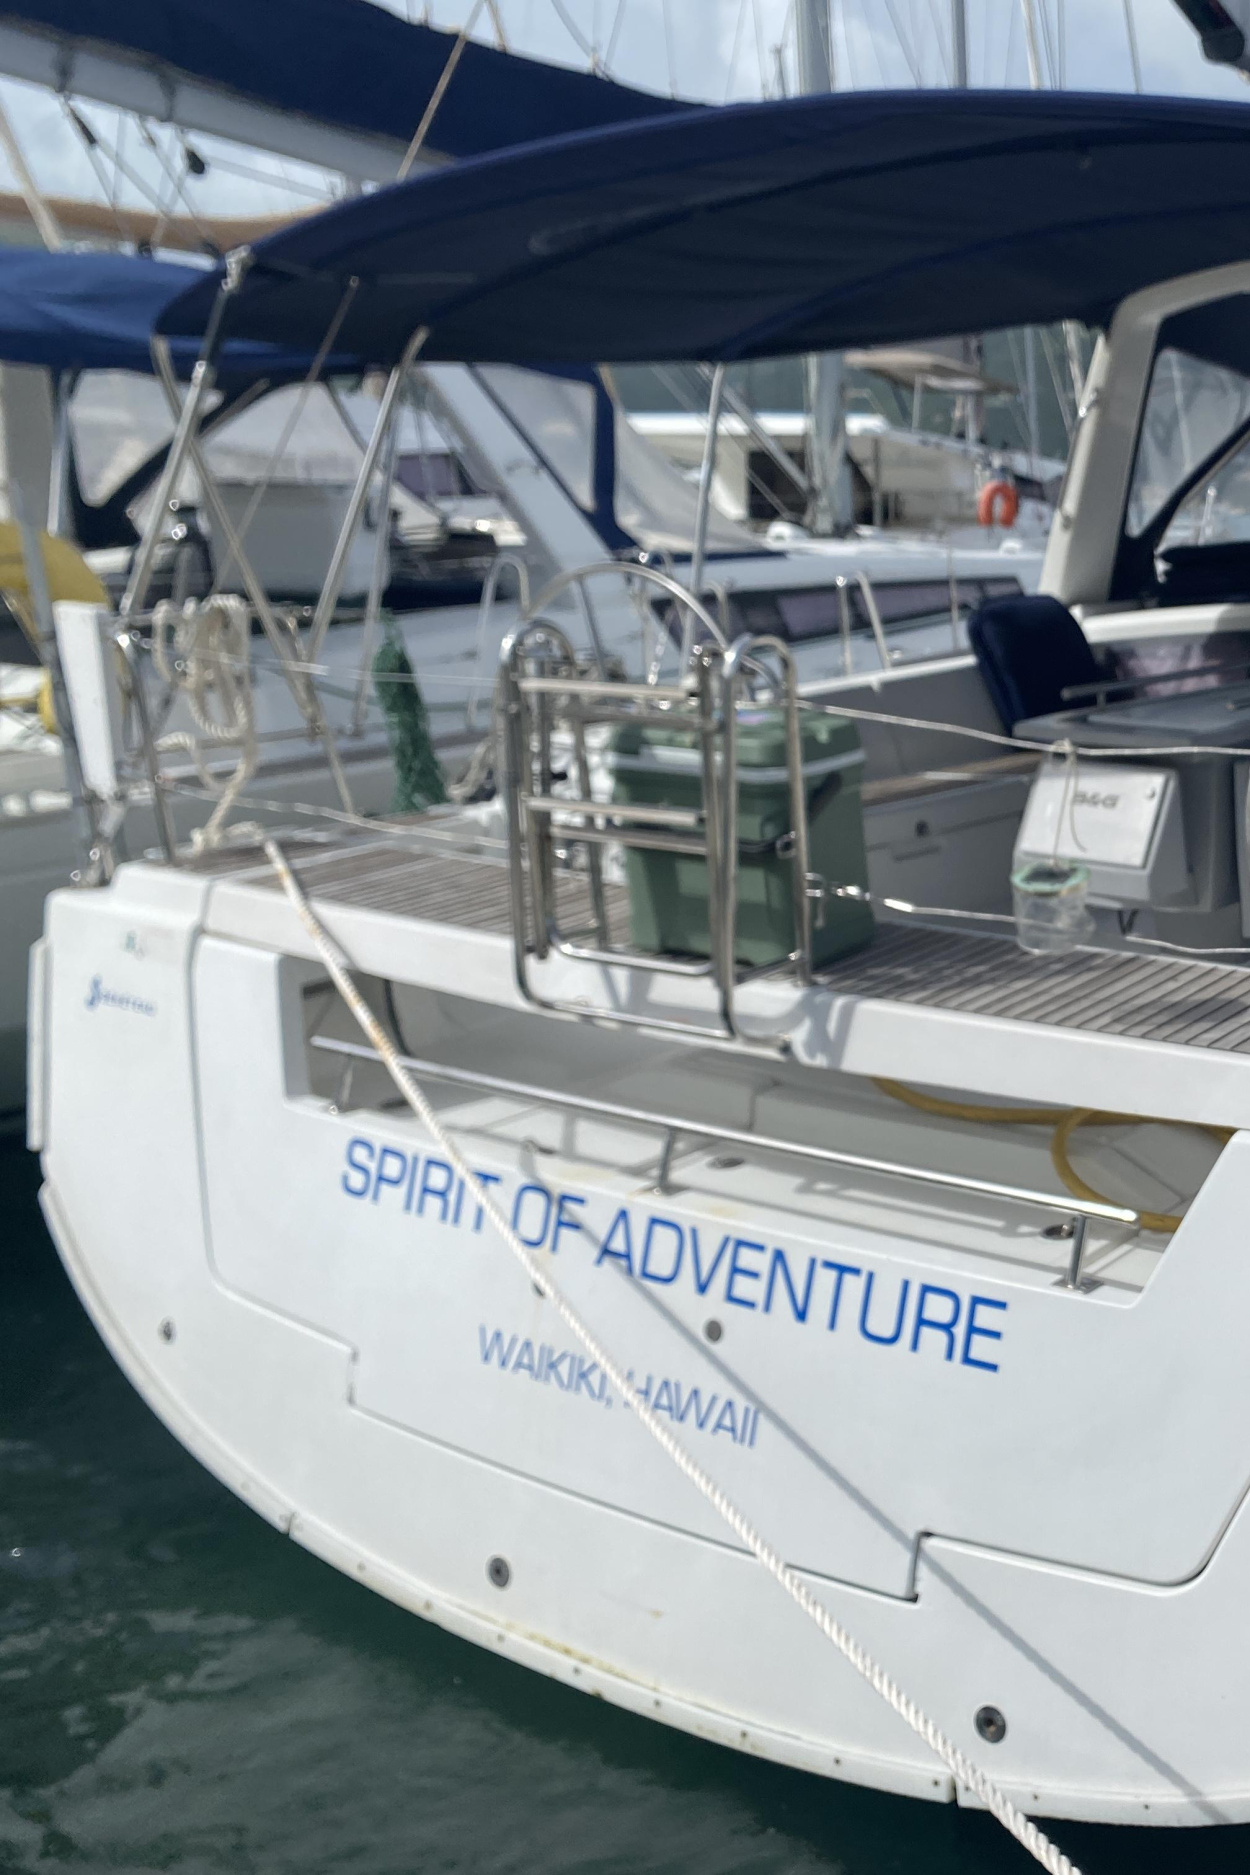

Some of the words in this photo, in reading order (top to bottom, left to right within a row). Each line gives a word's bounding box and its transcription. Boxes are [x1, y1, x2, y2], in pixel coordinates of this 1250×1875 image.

[341, 1137, 501, 1233] SPIRIT
[512, 1182, 586, 1253] OF
[597, 1208, 1008, 1373] ADVENTURE
[478, 1323, 613, 1409] WAIKIKI,
